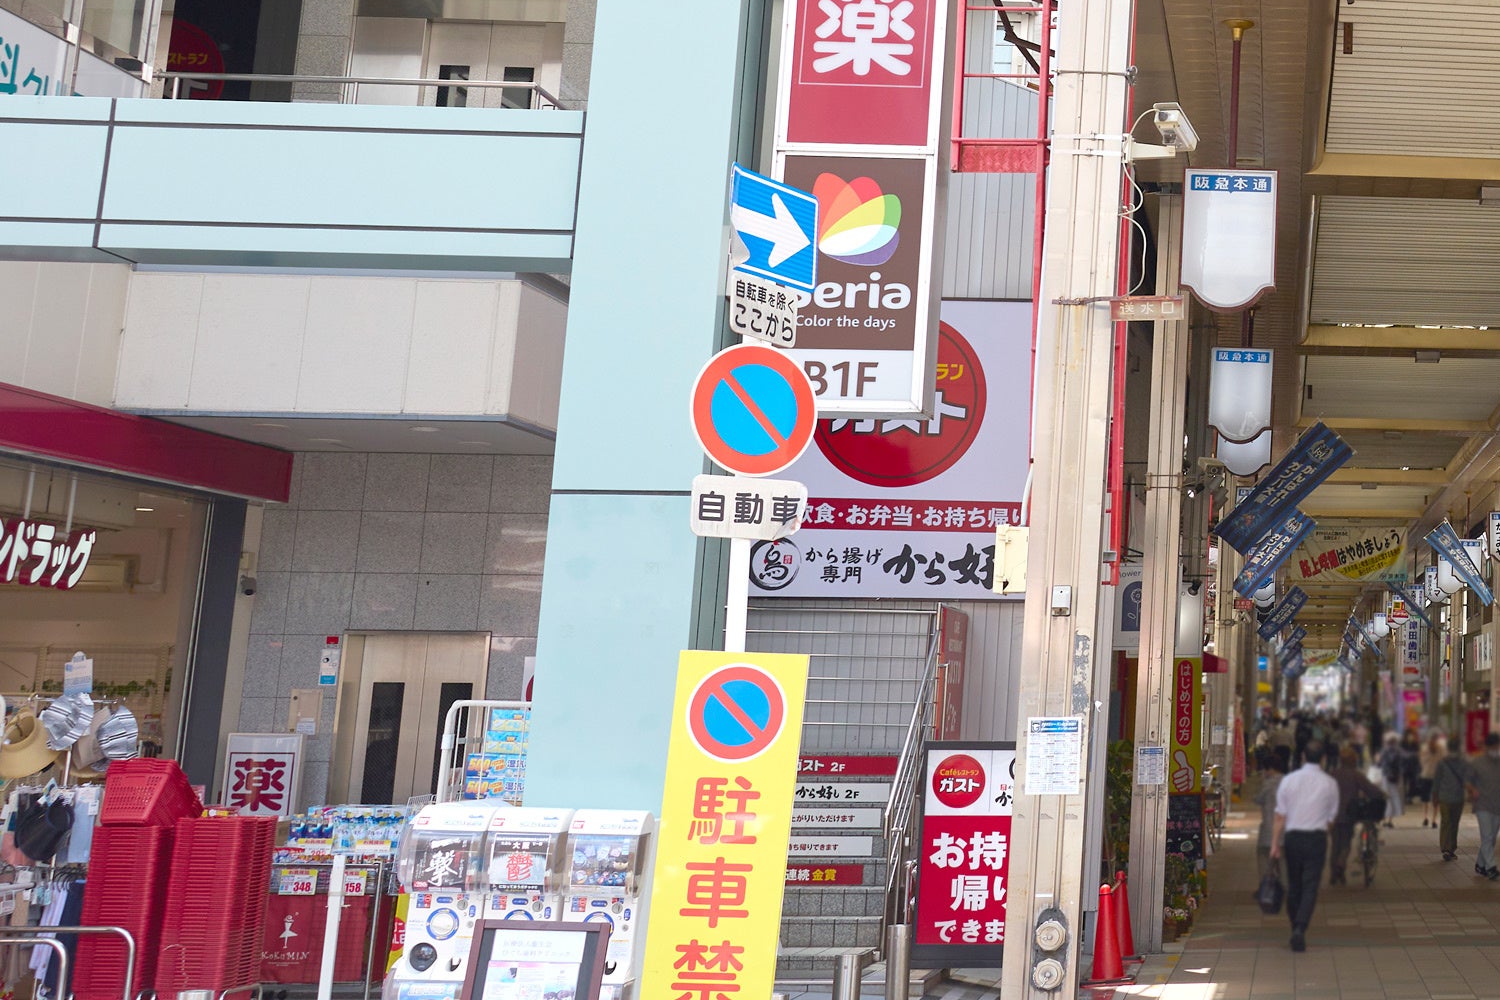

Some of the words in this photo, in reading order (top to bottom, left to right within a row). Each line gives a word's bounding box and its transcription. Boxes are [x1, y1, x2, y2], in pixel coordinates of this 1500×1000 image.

[1194, 176, 1269, 191] 阪急本通
[736, 279, 795, 313] 自転車を除く
[1119, 301, 1174, 315] 送水口
[734, 304, 793, 342] ここから
[796, 315, 833, 327] Color
[837, 315, 860, 328] the
[864, 315, 896, 332] days
[1218, 351, 1267, 362] 阪急本通
[804, 360, 879, 397] B1F
[698, 490, 801, 526] 自動車
[820, 566, 862, 584] 専門
[1178, 663, 1191, 742] はじめての方
[830, 762, 846, 772] 2F
[231, 758, 285, 812] 薬
[939, 778, 981, 793] ガスト
[845, 789, 860, 799] 2F
[293, 881, 311, 893] 348
